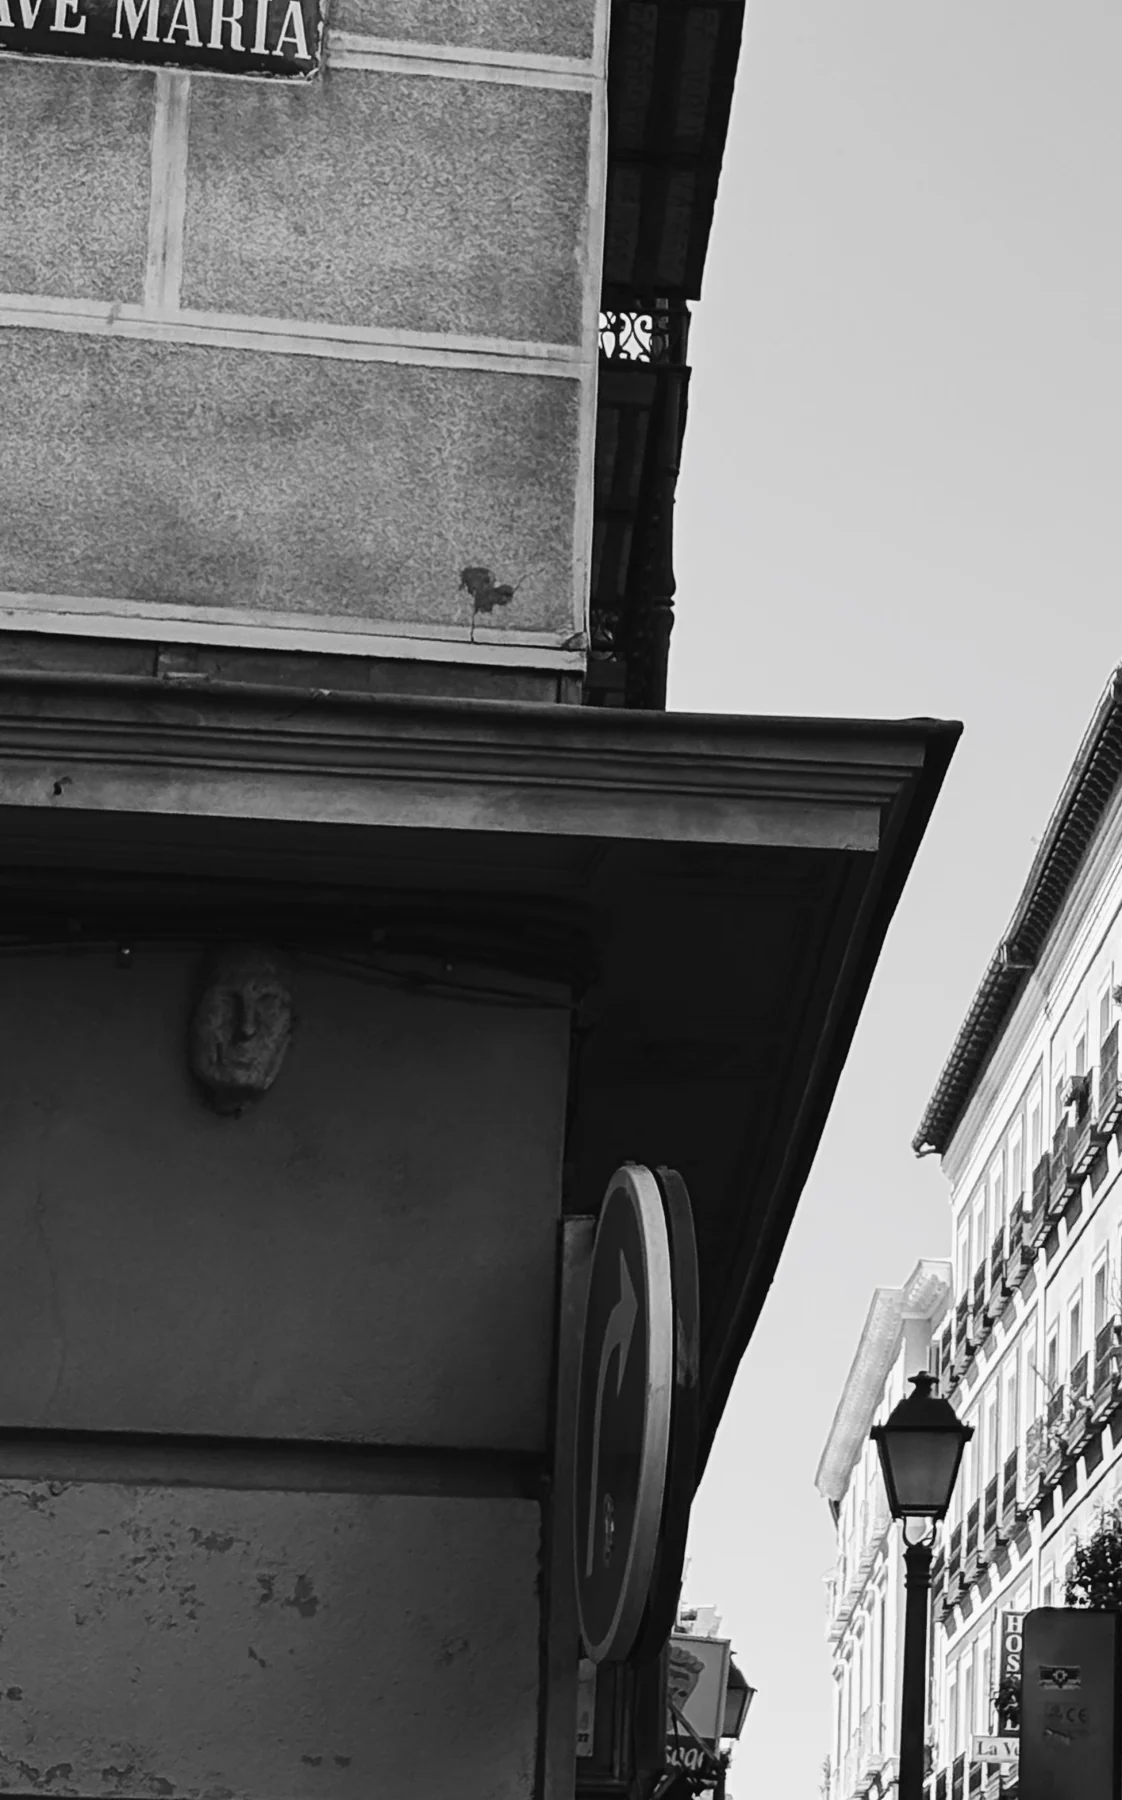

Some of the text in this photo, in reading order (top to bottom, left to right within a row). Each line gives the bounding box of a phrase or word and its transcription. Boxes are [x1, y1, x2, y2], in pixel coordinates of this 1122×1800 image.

[0, 0, 312, 60] VE MARIA
[976, 1741, 998, 1756] La
